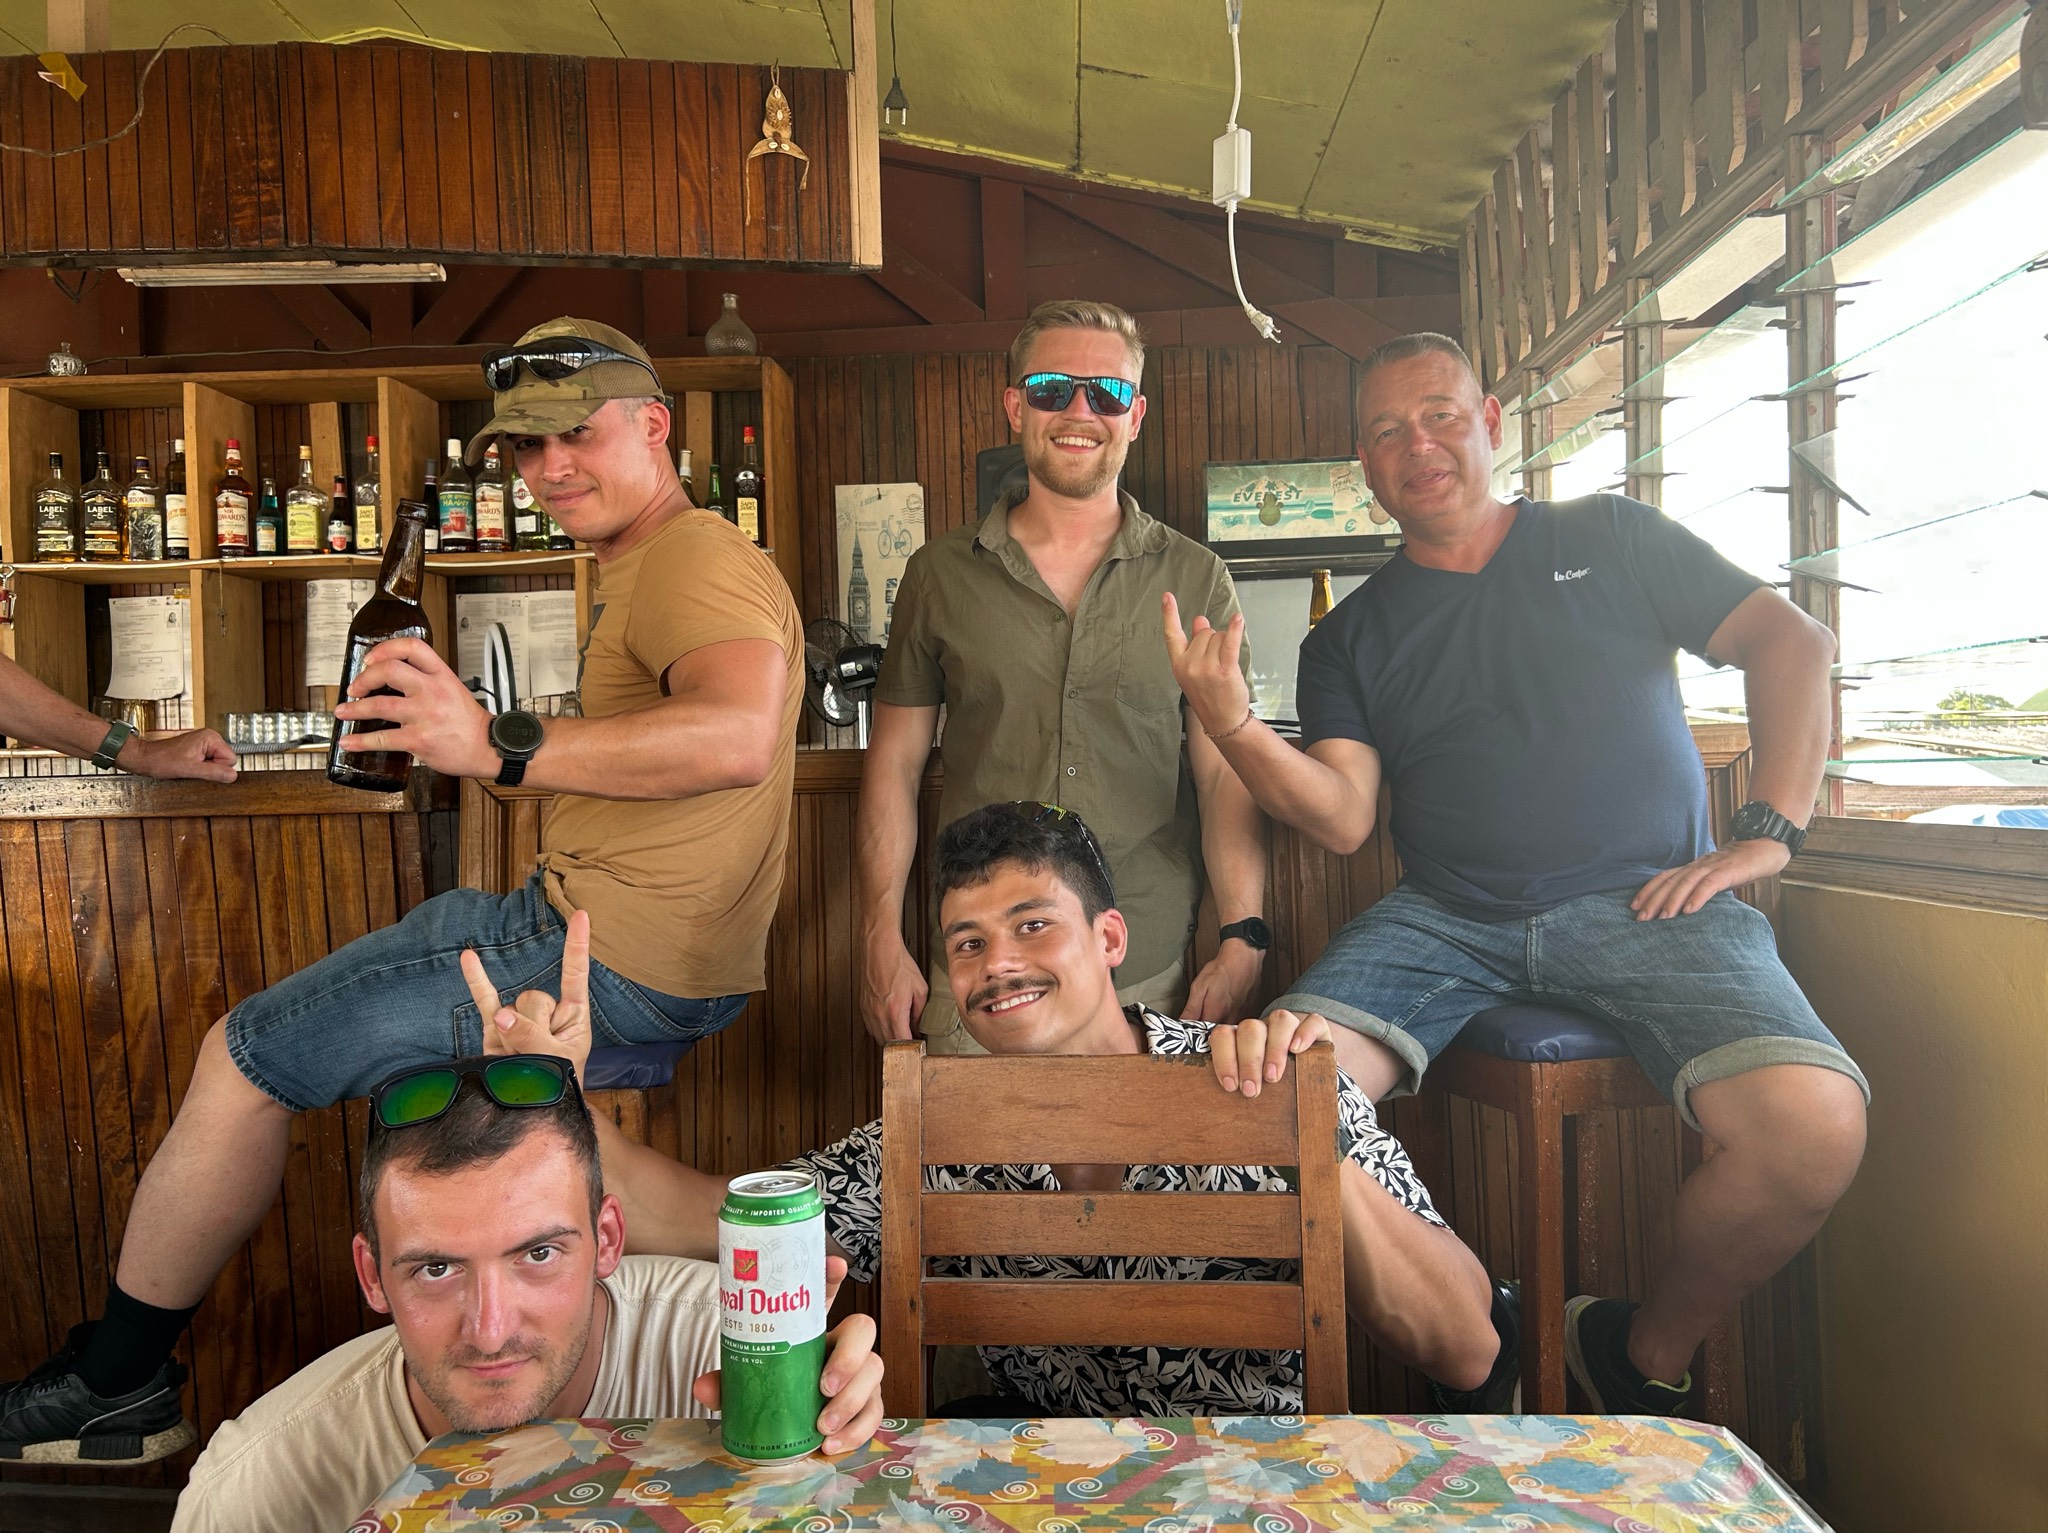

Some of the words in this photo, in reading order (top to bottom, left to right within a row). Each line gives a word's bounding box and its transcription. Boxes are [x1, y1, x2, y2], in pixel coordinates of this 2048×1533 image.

[1233, 489, 1303, 503] EVEEST
[750, 1208, 785, 1217] IMPORTED
[787, 1202, 811, 1214] QUALITY
[747, 1284, 810, 1315] Dutch
[749, 1323, 775, 1333] 1806
[724, 1338, 750, 1351] PREMIUM
[742, 1443, 757, 1451] POST
